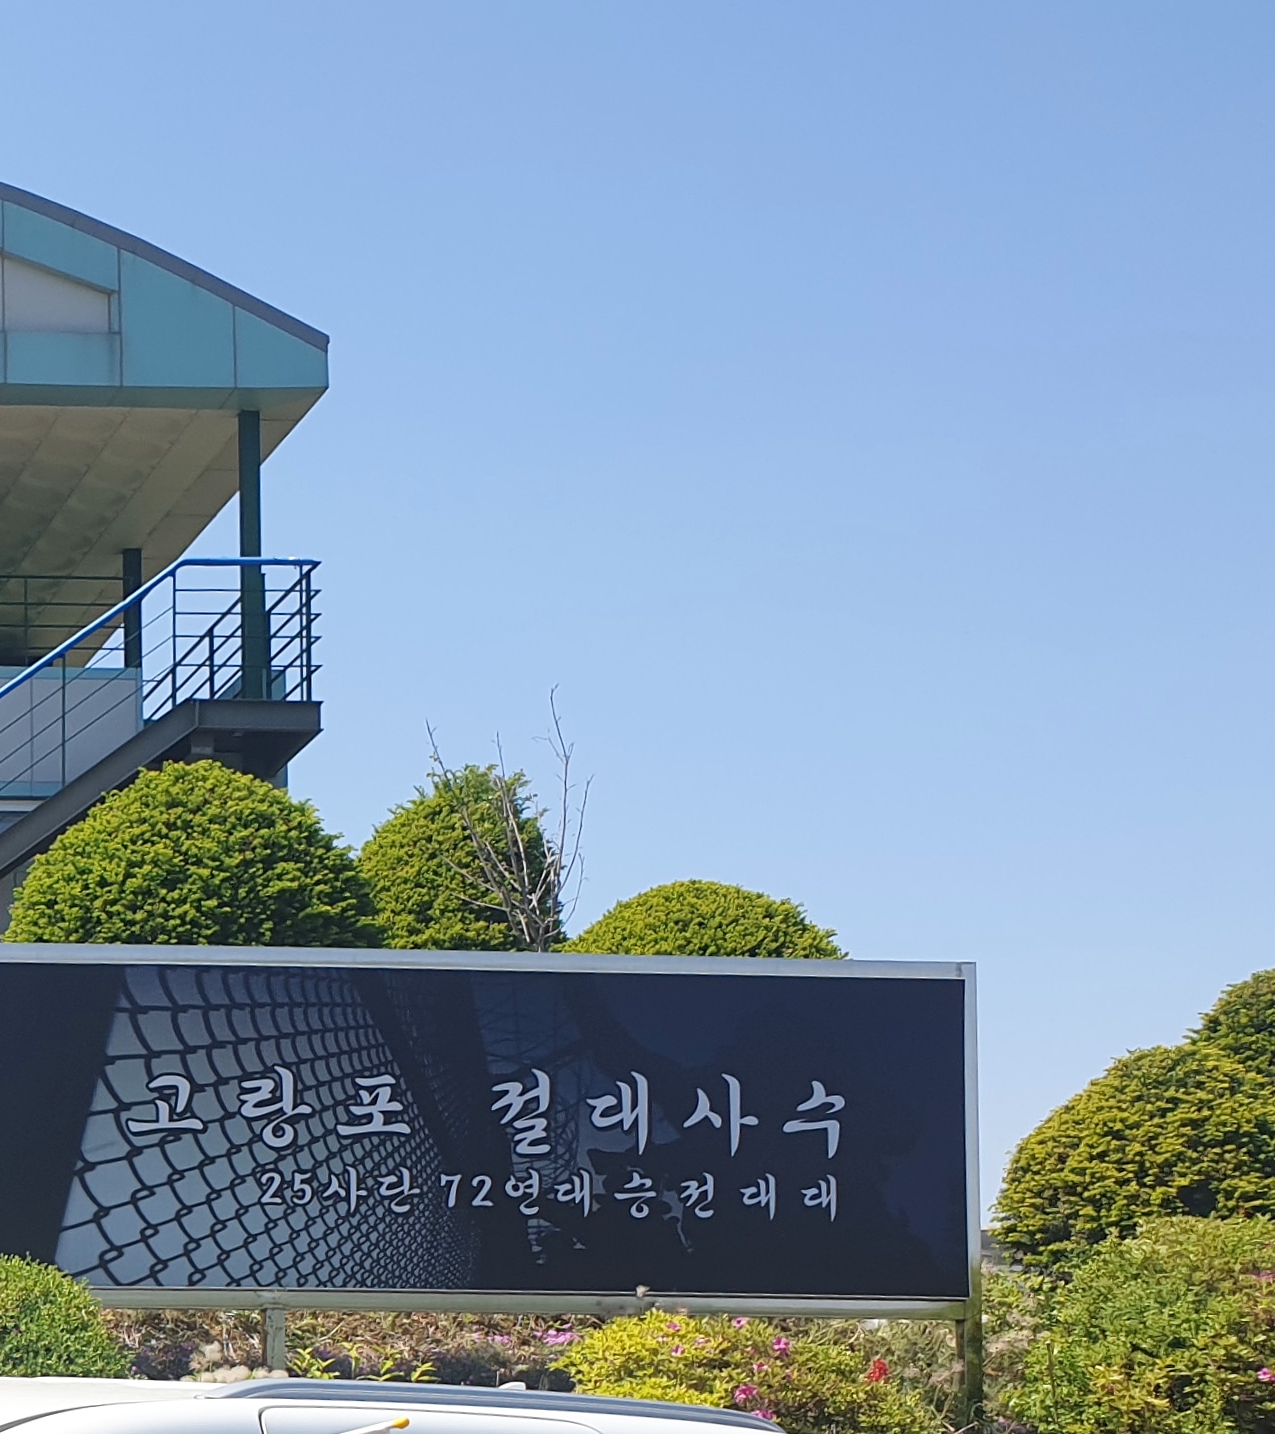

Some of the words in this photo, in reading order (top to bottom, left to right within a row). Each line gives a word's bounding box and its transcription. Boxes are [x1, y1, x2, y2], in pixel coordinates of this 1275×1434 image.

[126, 1064, 411, 1148] 고랑포
[491, 1068, 846, 1159] 절대사수
[258, 1166, 421, 1214] 25사단
[439, 1168, 593, 1218] 72연대
